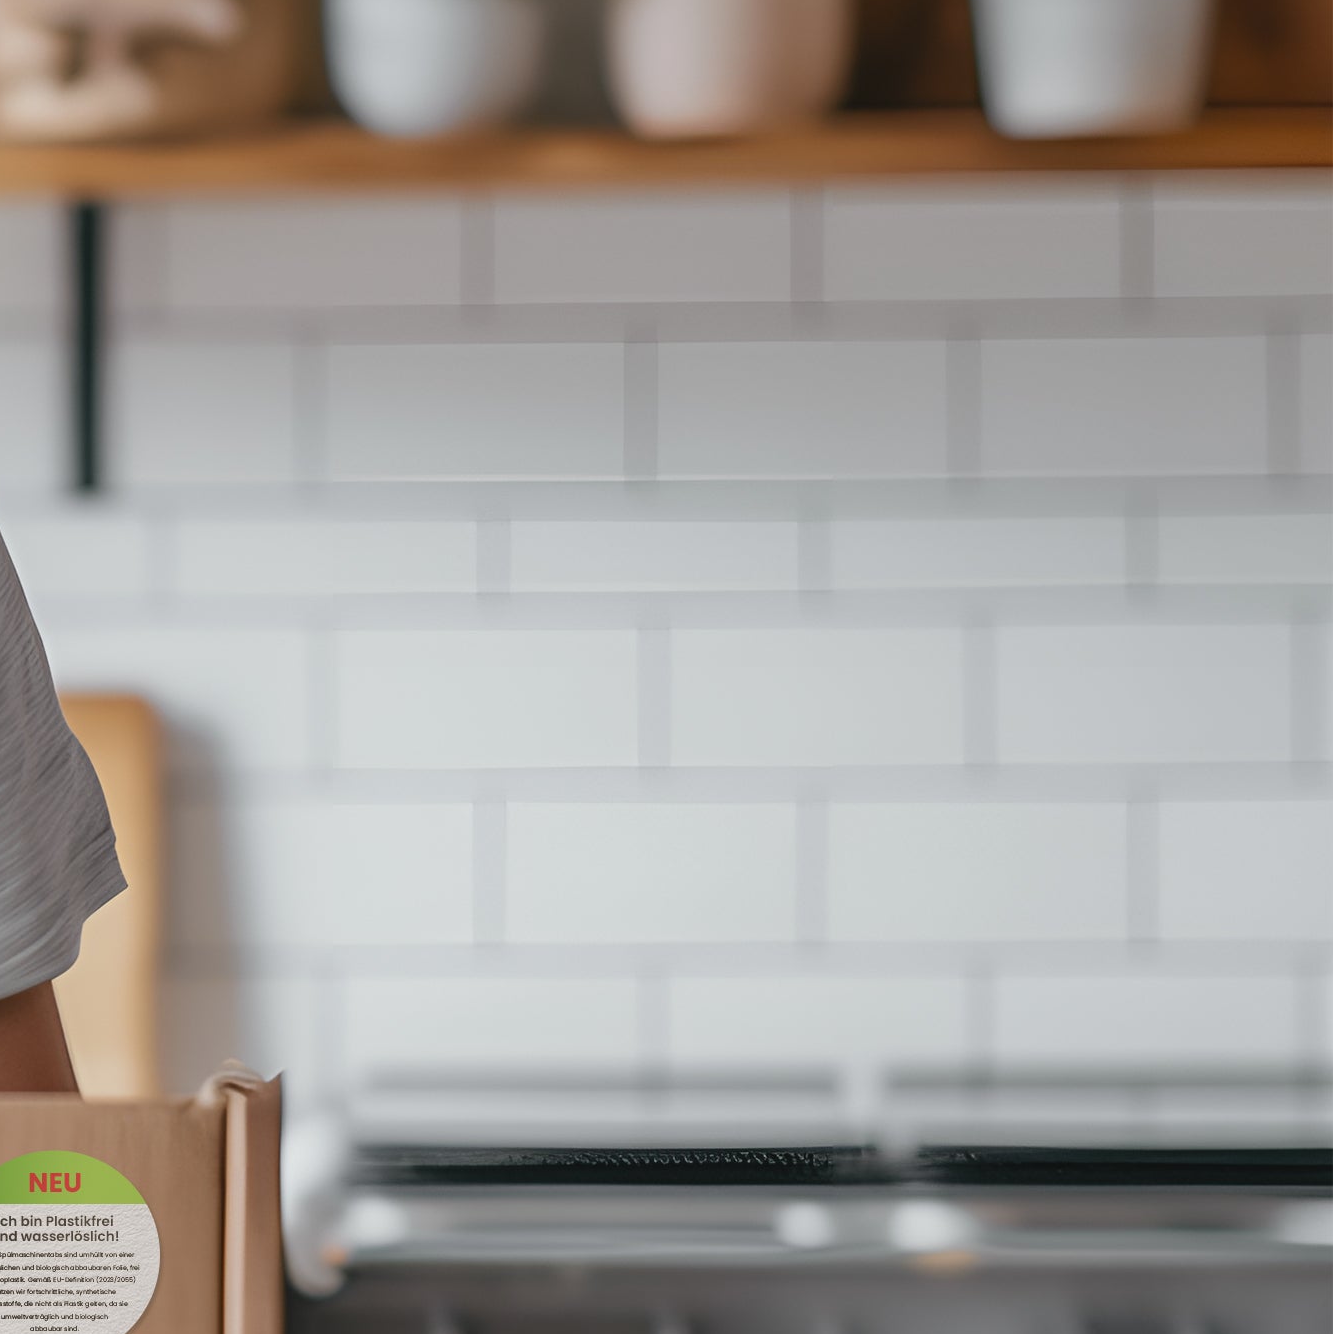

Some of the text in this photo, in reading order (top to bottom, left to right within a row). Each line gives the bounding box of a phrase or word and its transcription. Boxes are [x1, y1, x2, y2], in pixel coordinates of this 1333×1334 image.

[29, 1173, 81, 1192] NEU
[21, 1216, 42, 1226] bin
[46, 1215, 113, 1226] Plastikfrei
[21, 1231, 119, 1241] wasserlöslich!
[22, 1264, 34, 1272] und
[16, 1288, 25, 1296] wir
